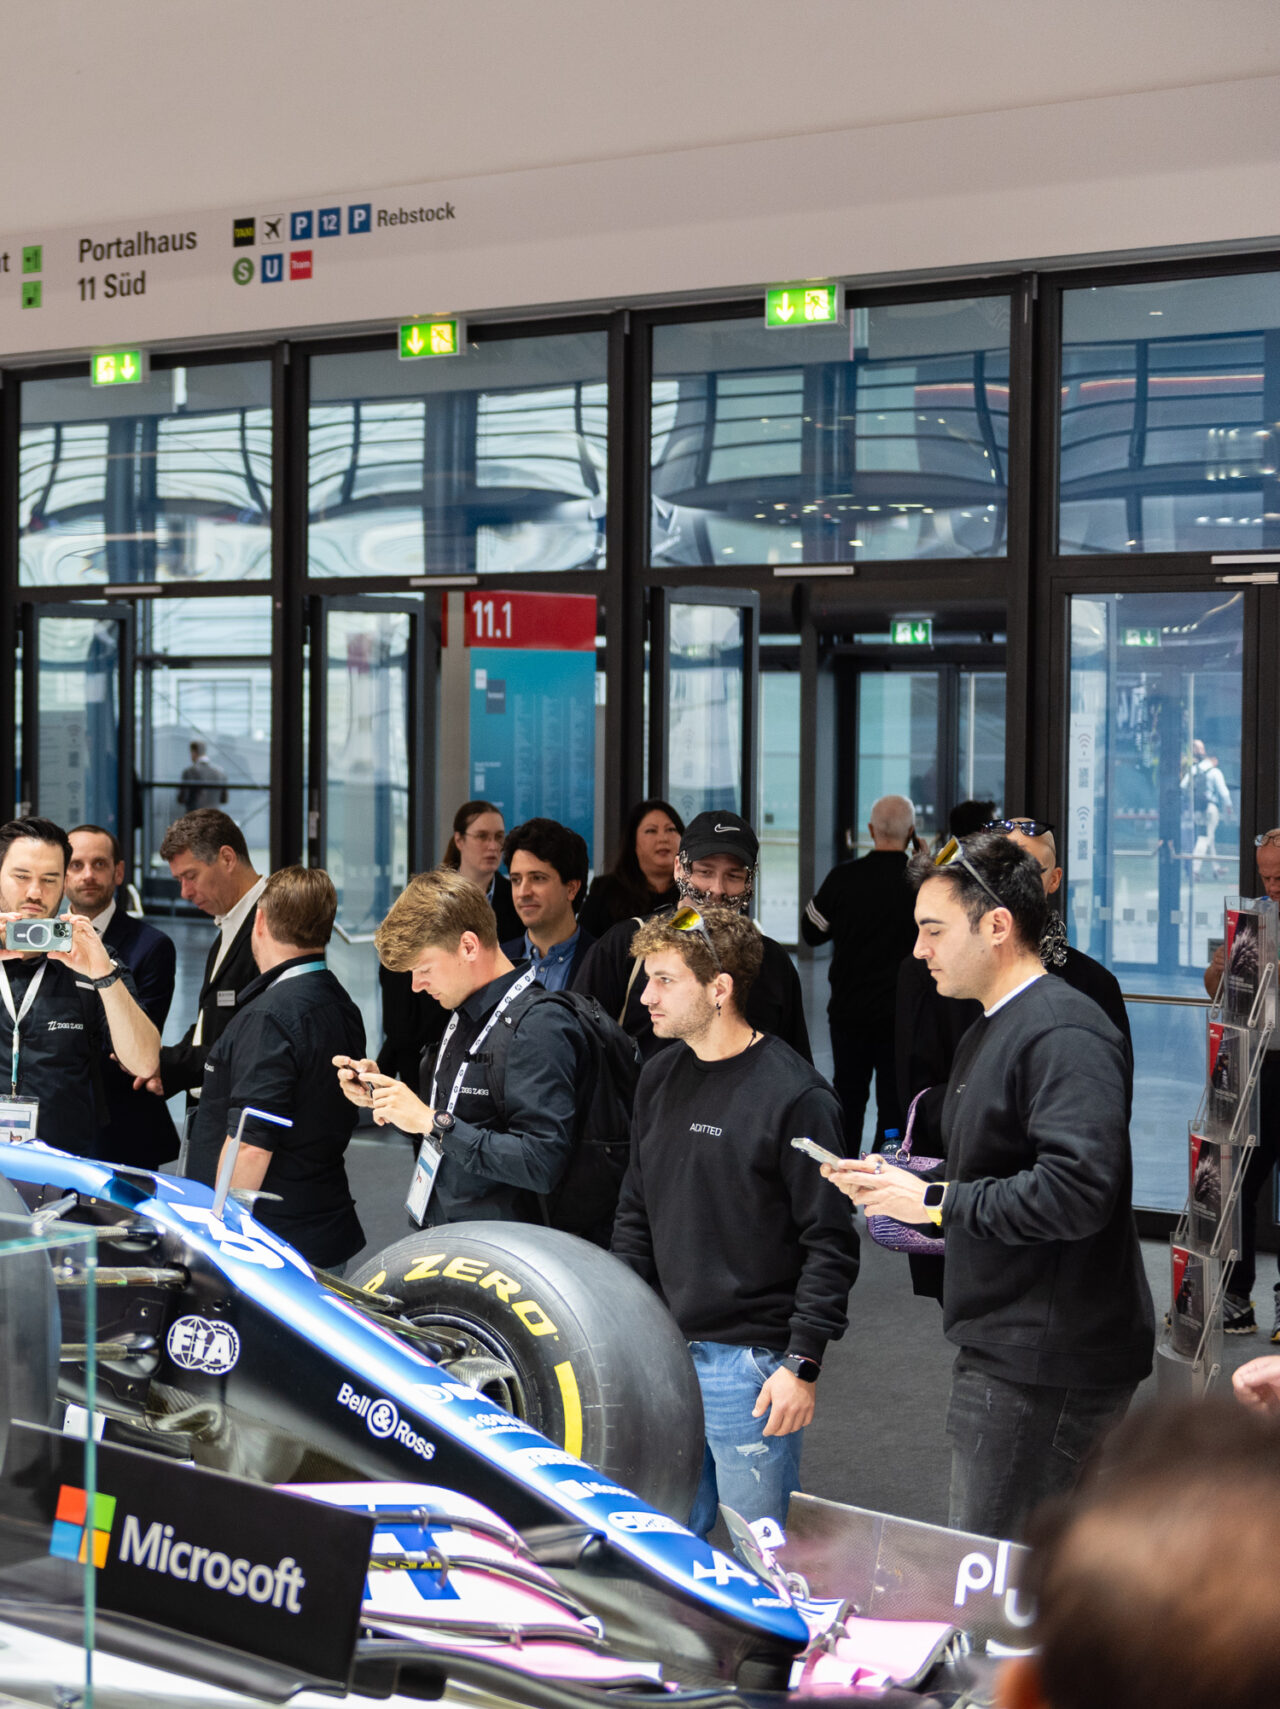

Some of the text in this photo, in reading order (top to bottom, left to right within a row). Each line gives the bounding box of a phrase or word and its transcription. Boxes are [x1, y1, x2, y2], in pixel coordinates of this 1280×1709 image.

[295, 216, 307, 236] P
[322, 213, 336, 232] 12
[353, 201, 456, 230] P Rebstock
[78, 231, 198, 263] Portalhaus
[237, 262, 249, 281] S
[265, 258, 279, 278] U
[77, 271, 147, 301] 11 Süd
[472, 600, 512, 638] 11.1
[690, 1123, 722, 1137] ADITTED
[403, 1253, 559, 1337] ZERO
[337, 1382, 370, 1418] Bell
[394, 1419, 437, 1461] Ross
[119, 1515, 306, 1614] Microsoft
